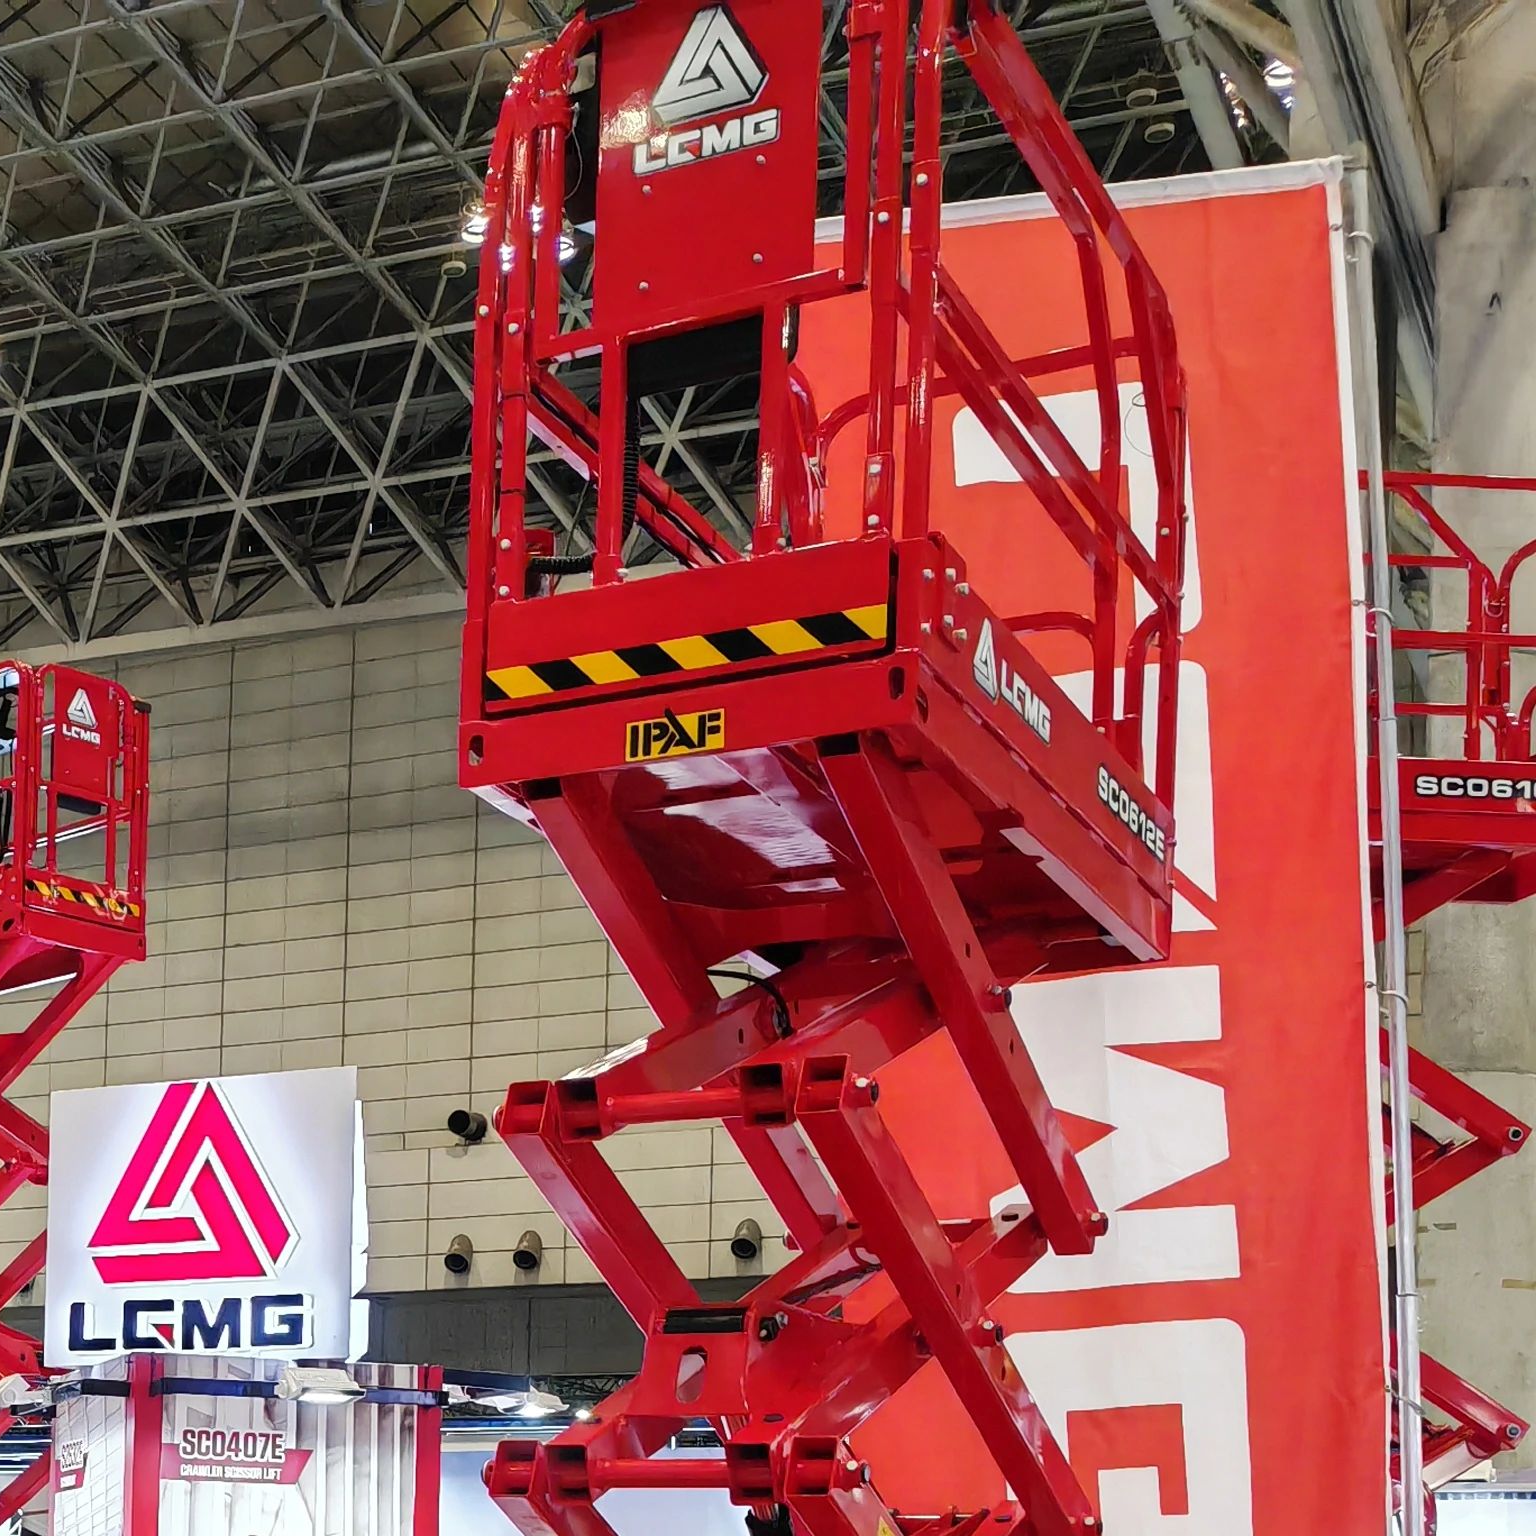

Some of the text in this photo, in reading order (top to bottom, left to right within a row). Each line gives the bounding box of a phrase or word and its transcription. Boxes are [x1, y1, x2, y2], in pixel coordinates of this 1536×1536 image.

[627, 706, 724, 760] IPAF
[1415, 775, 1536, 800] SC061
[180, 1463, 283, 1481] CRAWLER SCISSOR LIFT
